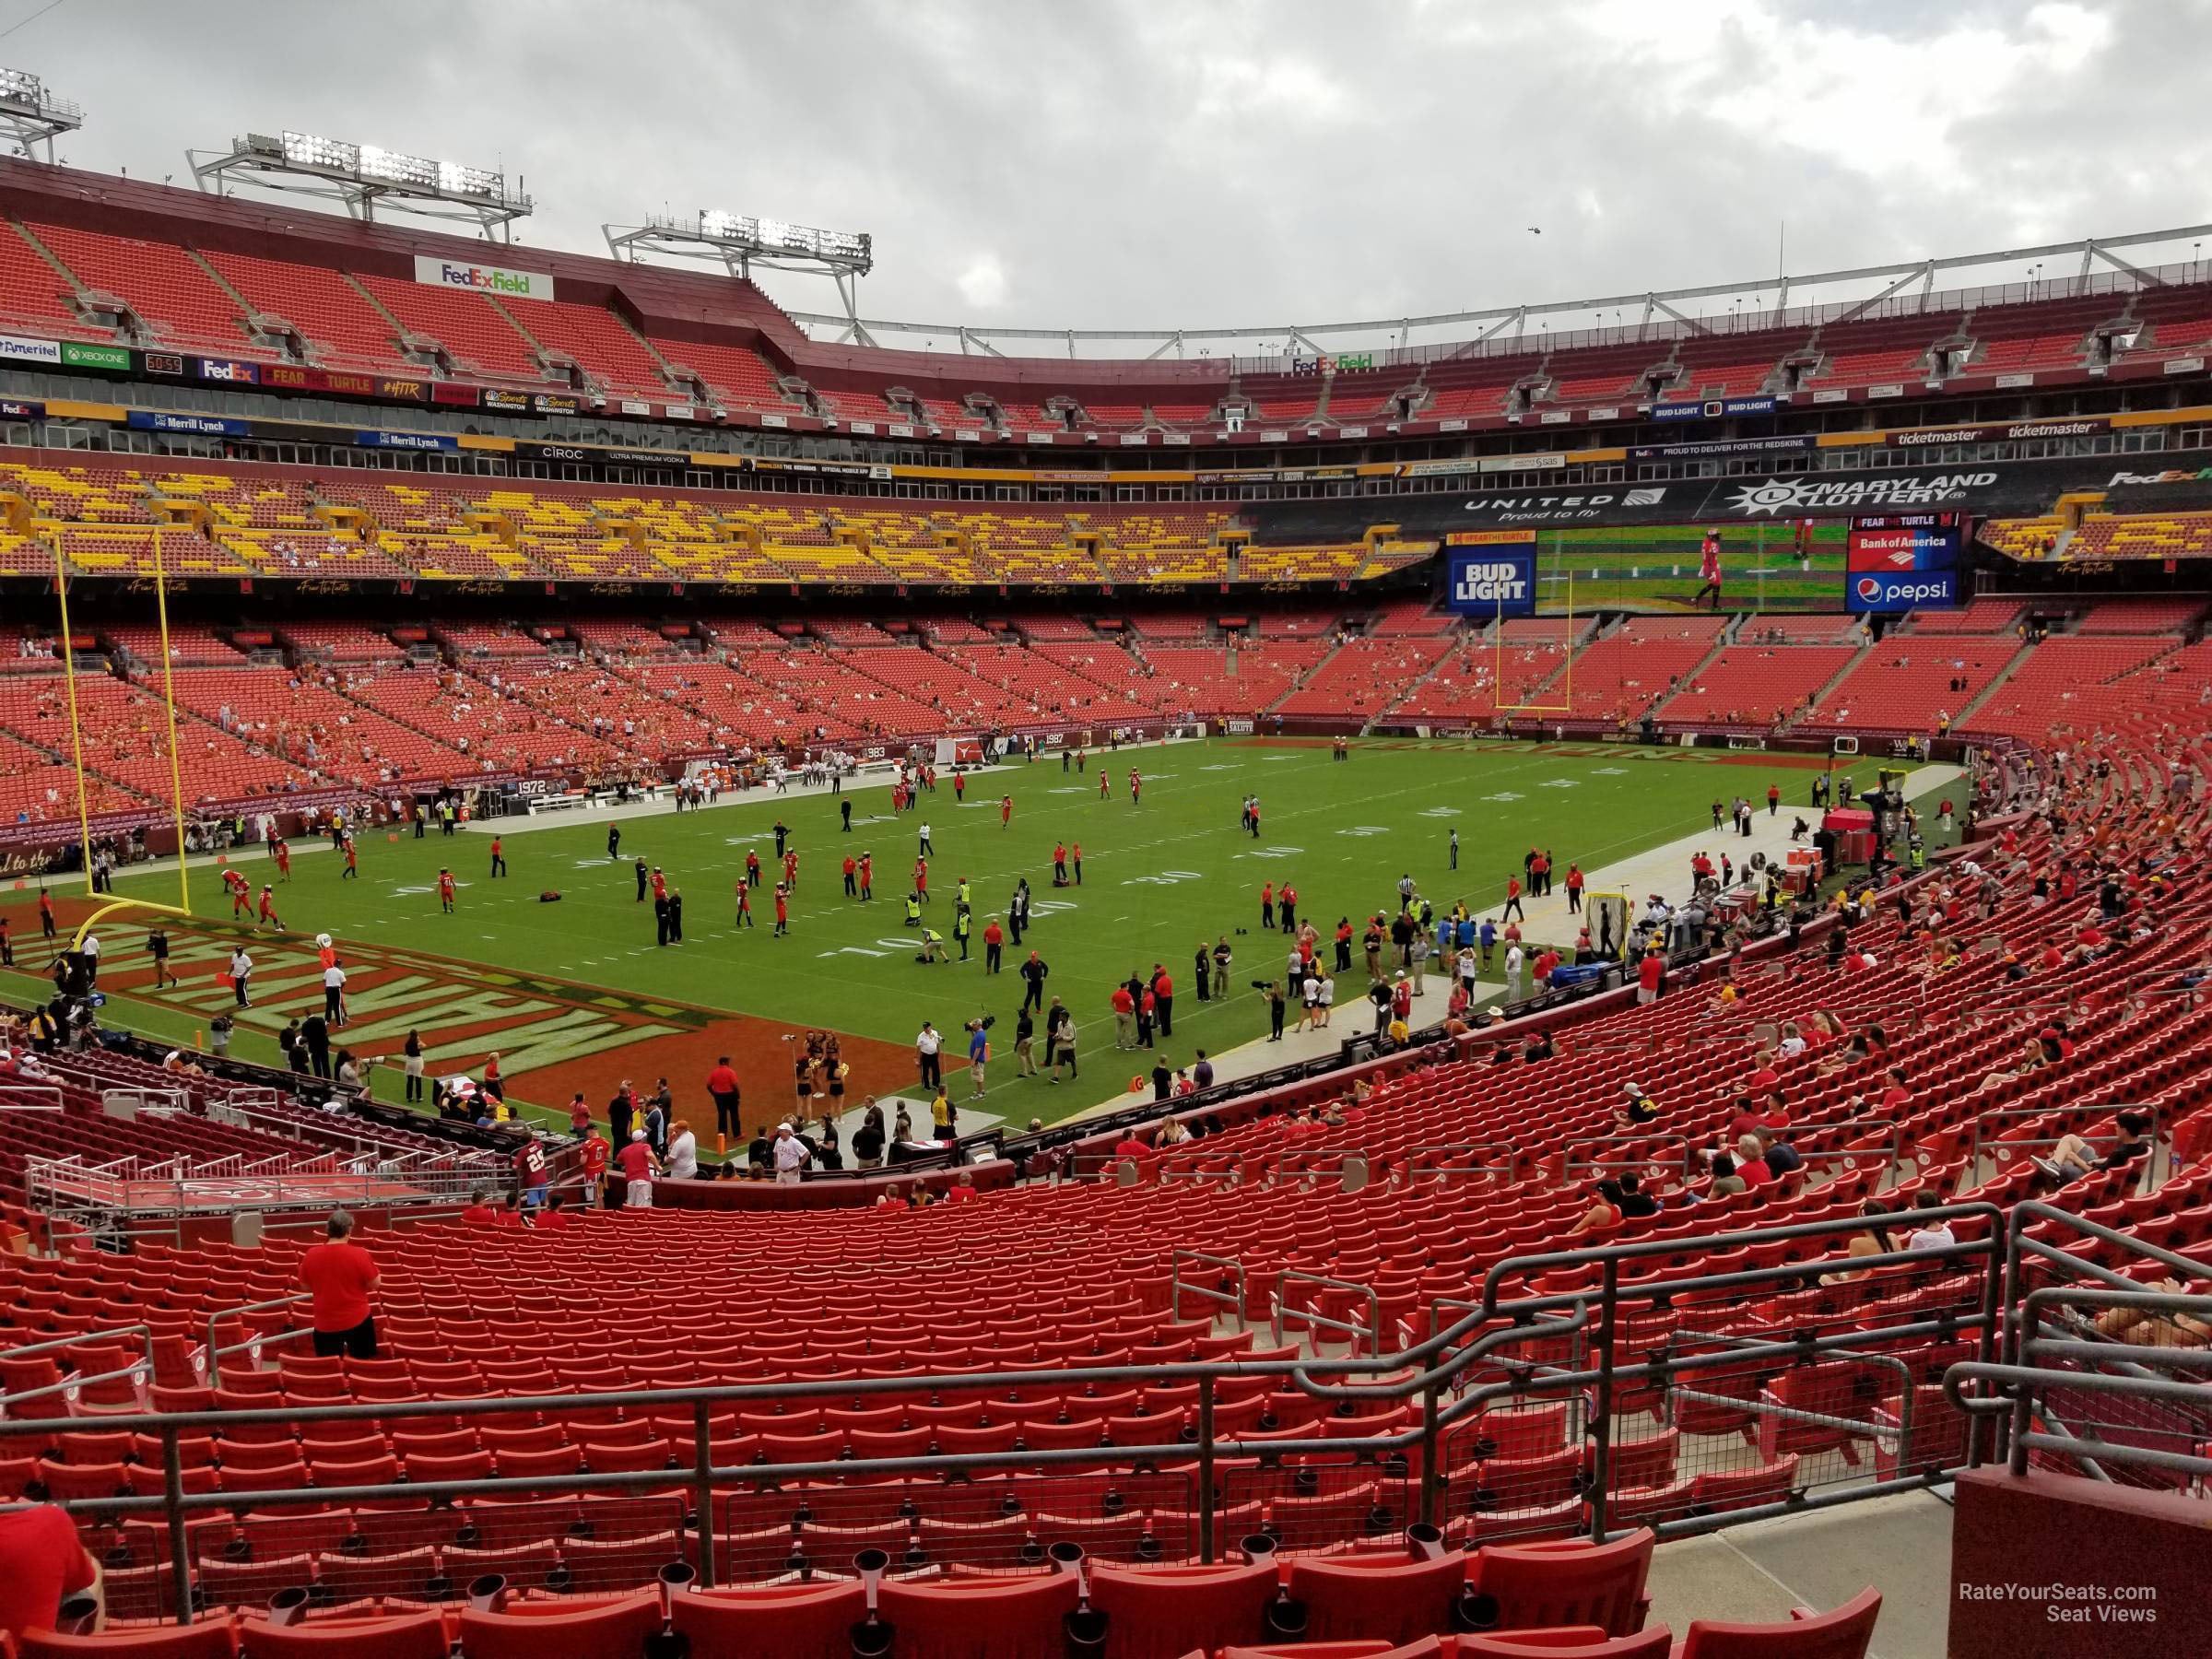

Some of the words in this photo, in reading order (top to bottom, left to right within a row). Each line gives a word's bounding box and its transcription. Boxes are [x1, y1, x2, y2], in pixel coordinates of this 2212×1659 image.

[441, 264, 530, 294] FedExField
[81, 352, 105, 361] XBOX
[106, 355, 126, 364] ONE
[1292, 354, 1372, 372] FedExField
[204, 360, 253, 381] FedEx
[273, 370, 305, 383] FEAR
[326, 374, 370, 392] TURTLE
[383, 381, 420, 398] #HTTR
[498, 391, 528, 404] Sports
[547, 397, 576, 408] Sports
[3, 404, 29, 415] FedEx
[487, 402, 525, 411] WASHINGTON
[536, 406, 574, 415] WASHINGTON
[1674, 407, 1699, 416] LIGHT
[1747, 402, 1771, 410] LIGHT
[168, 417, 197, 429] Merrill
[199, 419, 224, 432] Lynch
[2008, 423, 2092, 438] ticketmaster
[391, 435, 416, 445] Merrill
[418, 438, 439, 448] Lynch
[1899, 430, 1977, 445] ticketmaster
[1664, 447, 1688, 455] PROUD
[1701, 444, 1731, 453] DELIVER
[1817, 473, 1998, 495] MARYLAND
[1465, 496, 1614, 510] UNITED
[1806, 488, 1956, 507] LOTTERY
[1498, 511, 1550, 523] Proud
[1555, 510, 1572, 518] to
[1577, 509, 1601, 518] fly
[1860, 538, 1888, 548] Bank
[1888, 537, 1899, 547] of
[1900, 535, 1947, 547] America
[1465, 563, 1516, 582] BUD
[1456, 581, 1526, 600] LIGHT
[1887, 581, 1947, 603] pepsi
[1046, 734, 1063, 744] 1987
[518, 781, 546, 794] 1972
[1250, 846, 1304, 858] 40
[13, 853, 28, 870] to
[30, 850, 53, 868] the
[1135, 871, 1202, 885] 30
[839, 938, 924, 957] 10
[526, 1149, 545, 1172] 29
